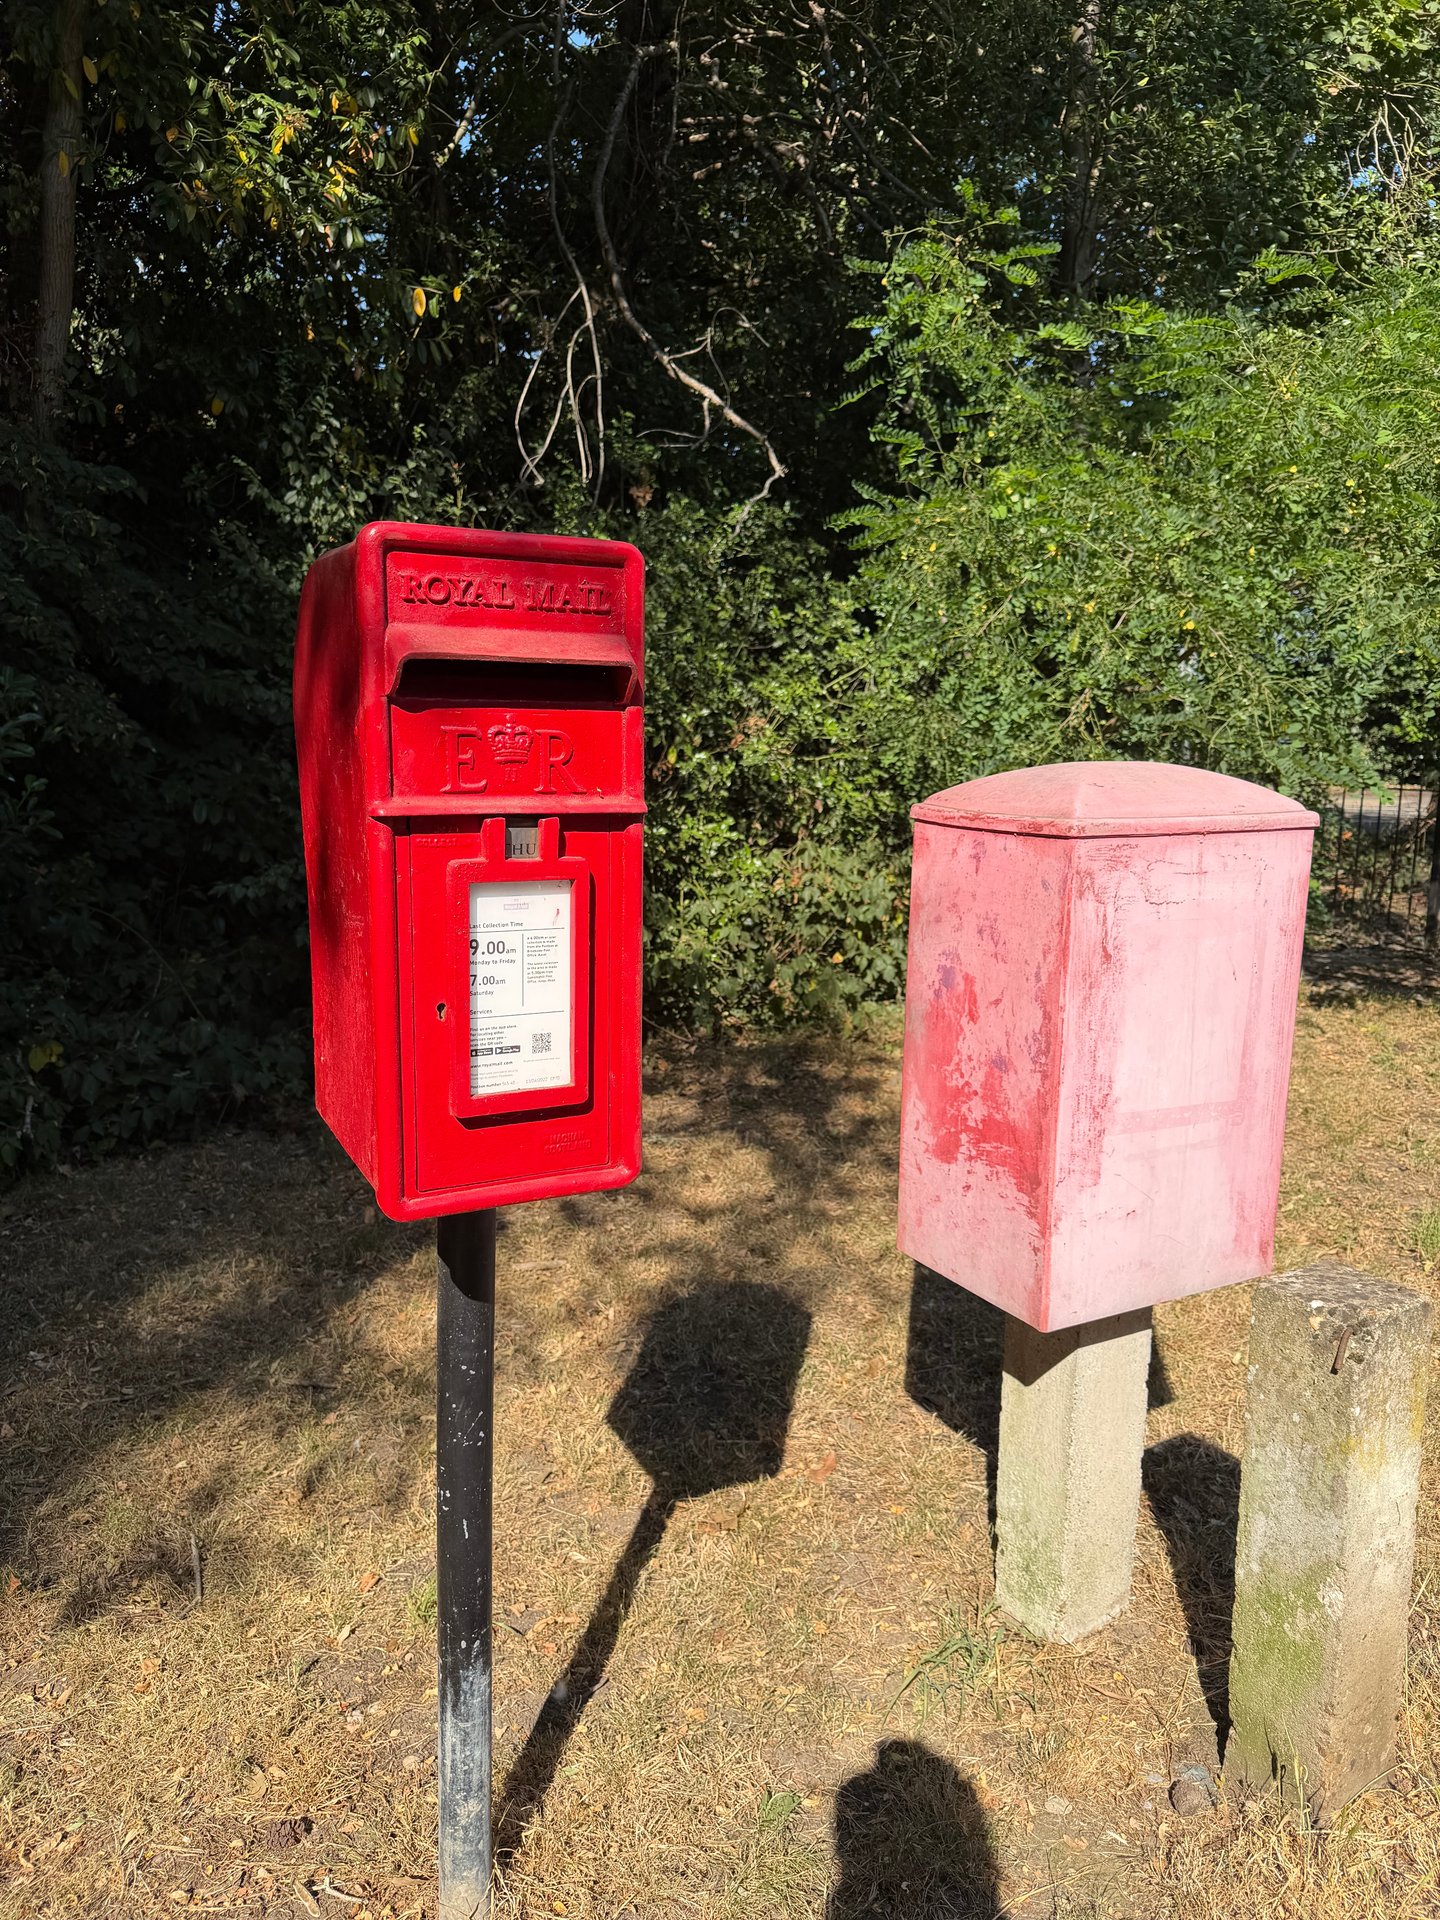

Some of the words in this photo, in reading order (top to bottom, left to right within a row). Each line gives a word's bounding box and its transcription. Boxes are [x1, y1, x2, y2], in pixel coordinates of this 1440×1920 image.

[400, 573, 514, 609] ROYAL
[523, 578, 611, 615] MAIL
[482, 921, 509, 929] Collection
[510, 920, 524, 928] Time
[470, 938, 517, 956] 9.00am
[470, 974, 506, 987] 7.00am
[470, 1008, 493, 1016] Services
